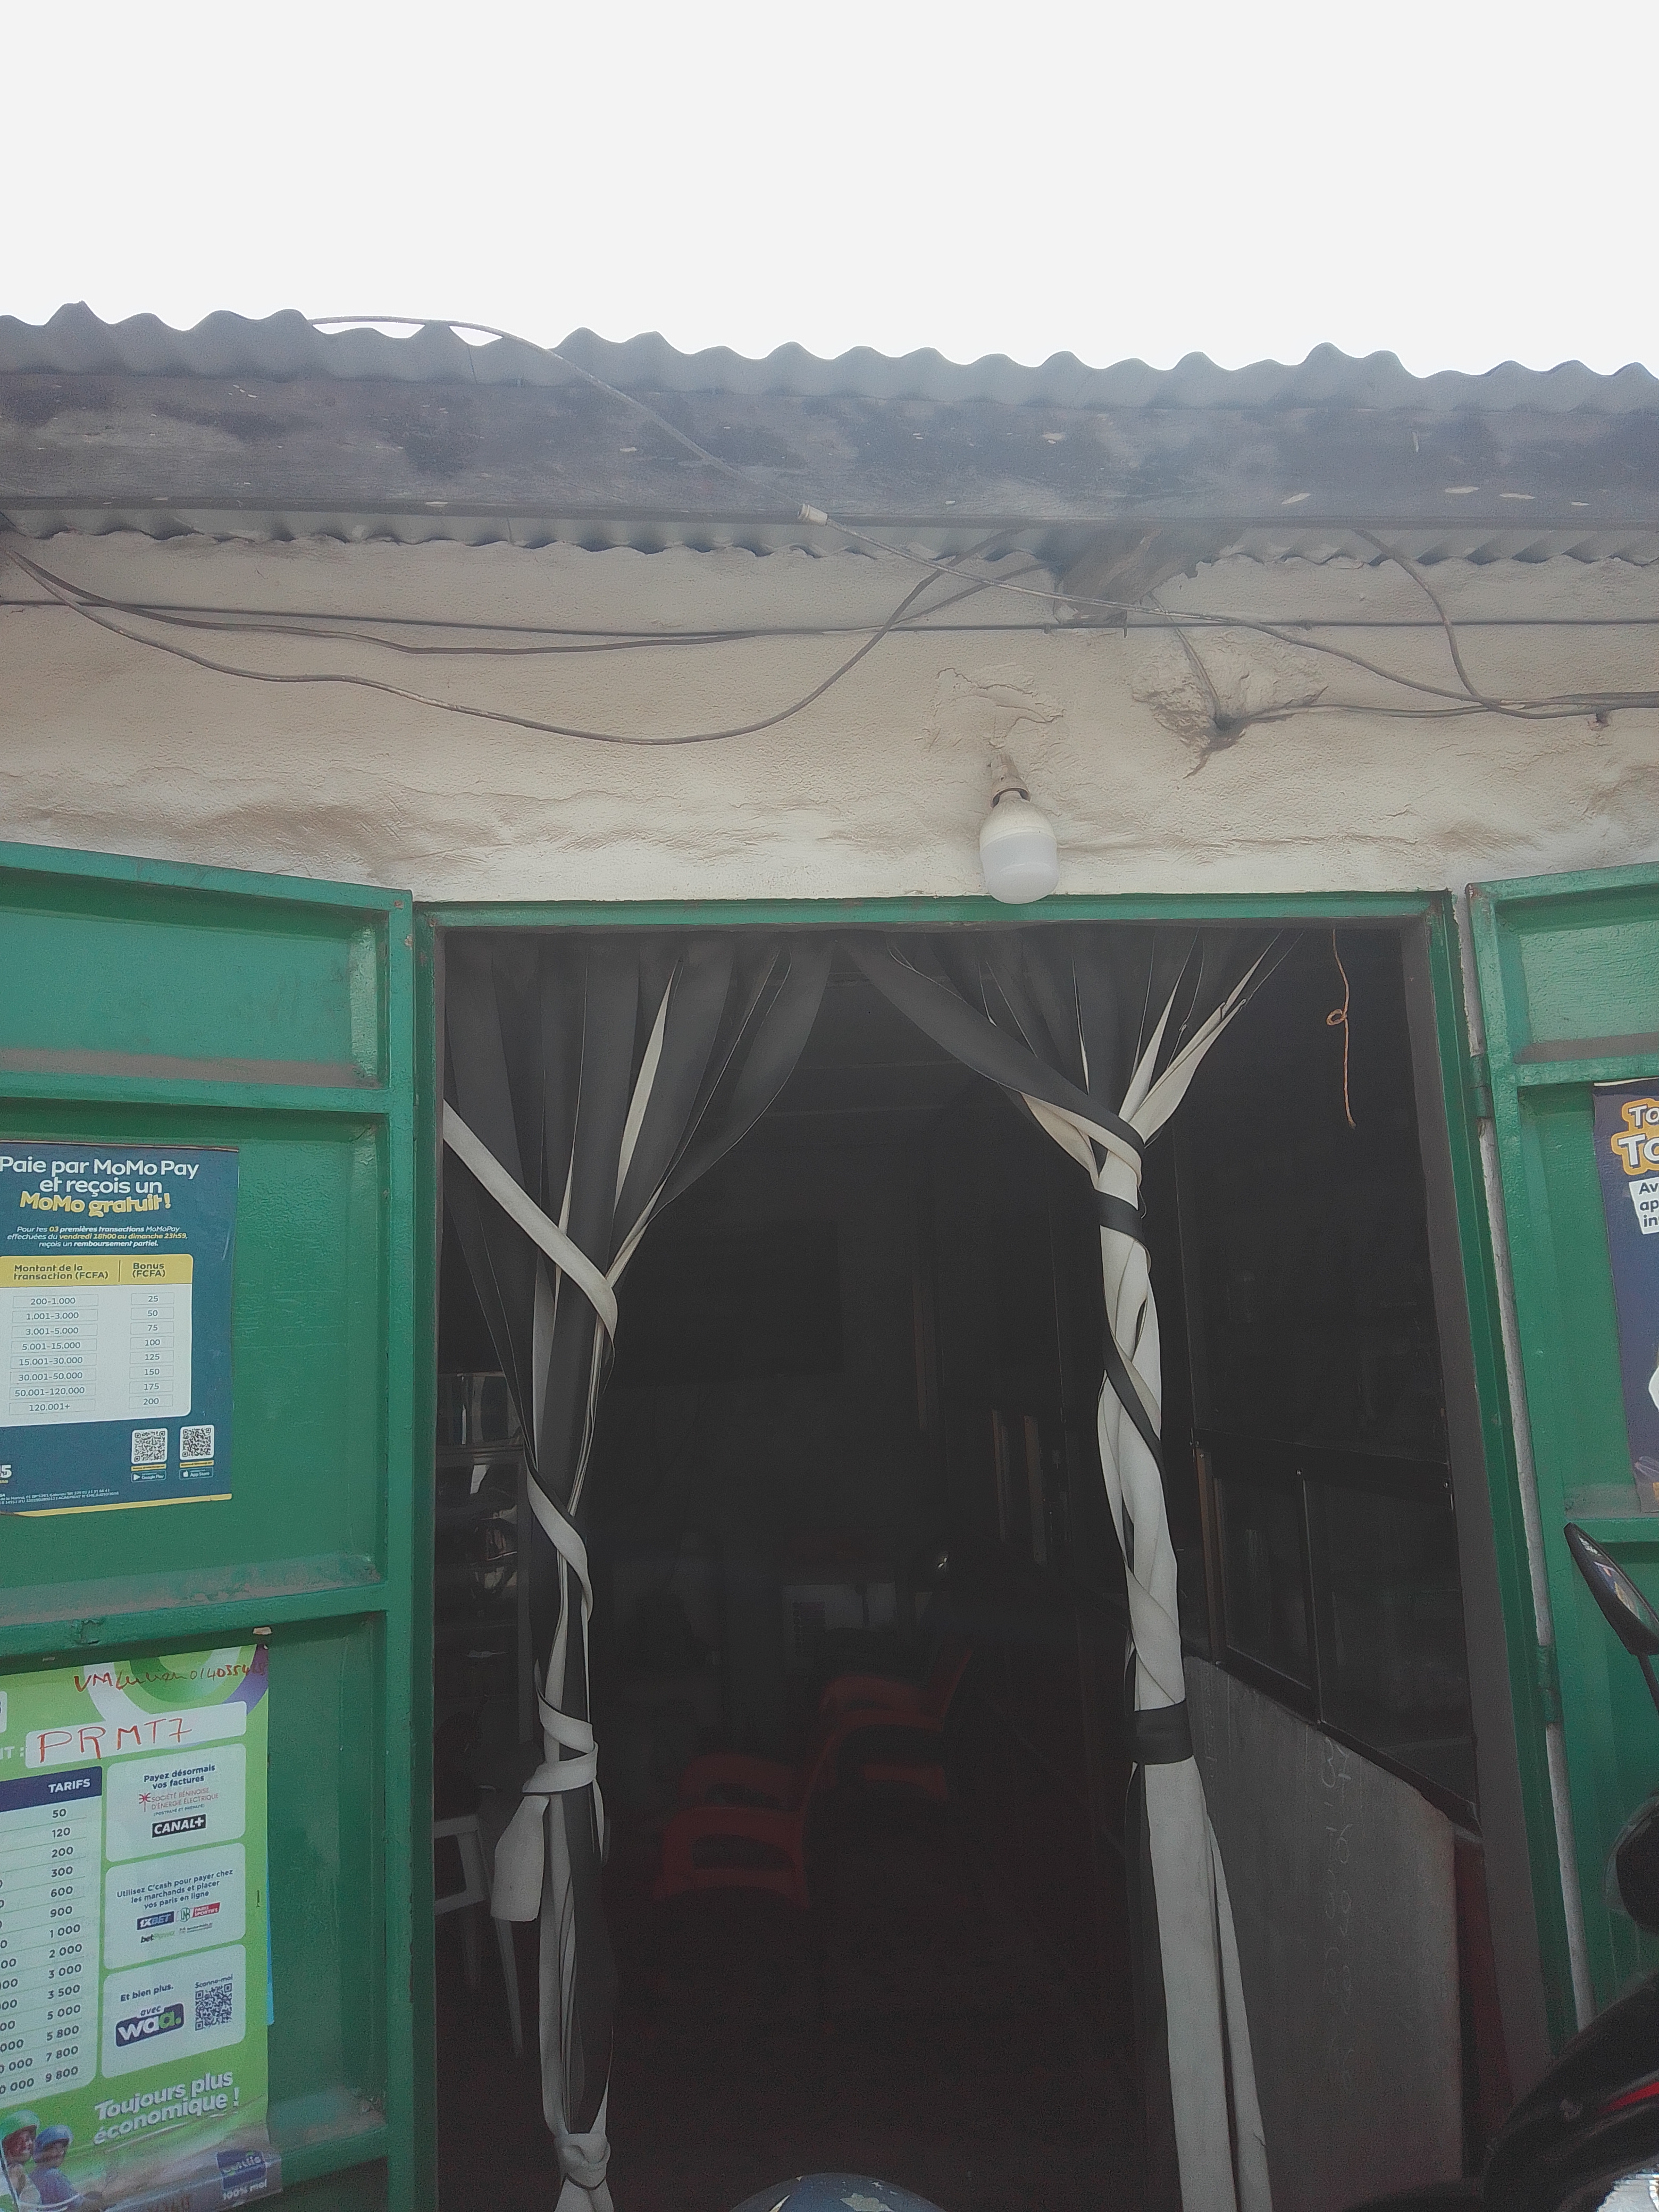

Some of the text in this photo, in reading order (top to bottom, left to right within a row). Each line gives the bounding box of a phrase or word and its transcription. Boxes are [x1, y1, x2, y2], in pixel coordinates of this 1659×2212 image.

[0, 1156, 199, 1179] Paie par MoMo Pay
[39, 1177, 162, 1197] et reçois un
[1638, 1182, 1658, 1195] Av
[20, 1191, 86, 1213] MoMo
[1640, 1200, 1658, 1212] ap
[14, 1271, 72, 1280] transaction
[144, 1764, 215, 1782] Payez désormais
[48, 1779, 90, 1793] TARIFS
[170, 1775, 204, 1787] factures
[52, 1808, 66, 1819] 50
[153, 1816, 205, 1834] CANAL+
[52, 1828, 71, 1838] 120
[51, 1846, 73, 1858] 200
[51, 1866, 73, 1878] 300
[117, 1869, 233, 1898] Utilisez C'cash pour payer chez
[144, 1887, 185, 1901] marchands
[197, 1880, 220, 1890] placer
[51, 1886, 73, 1897] 600
[160, 1896, 178, 1907] paris
[191, 1890, 210, 1899] ligne
[50, 1906, 72, 1917] 900
[132, 1989, 151, 1999] bien
[153, 1983, 174, 1995] plus.
[140, 2005, 161, 2016] avec
[94, 2071, 233, 2120] Toujours plus
[93, 2092, 228, 2145] économique
